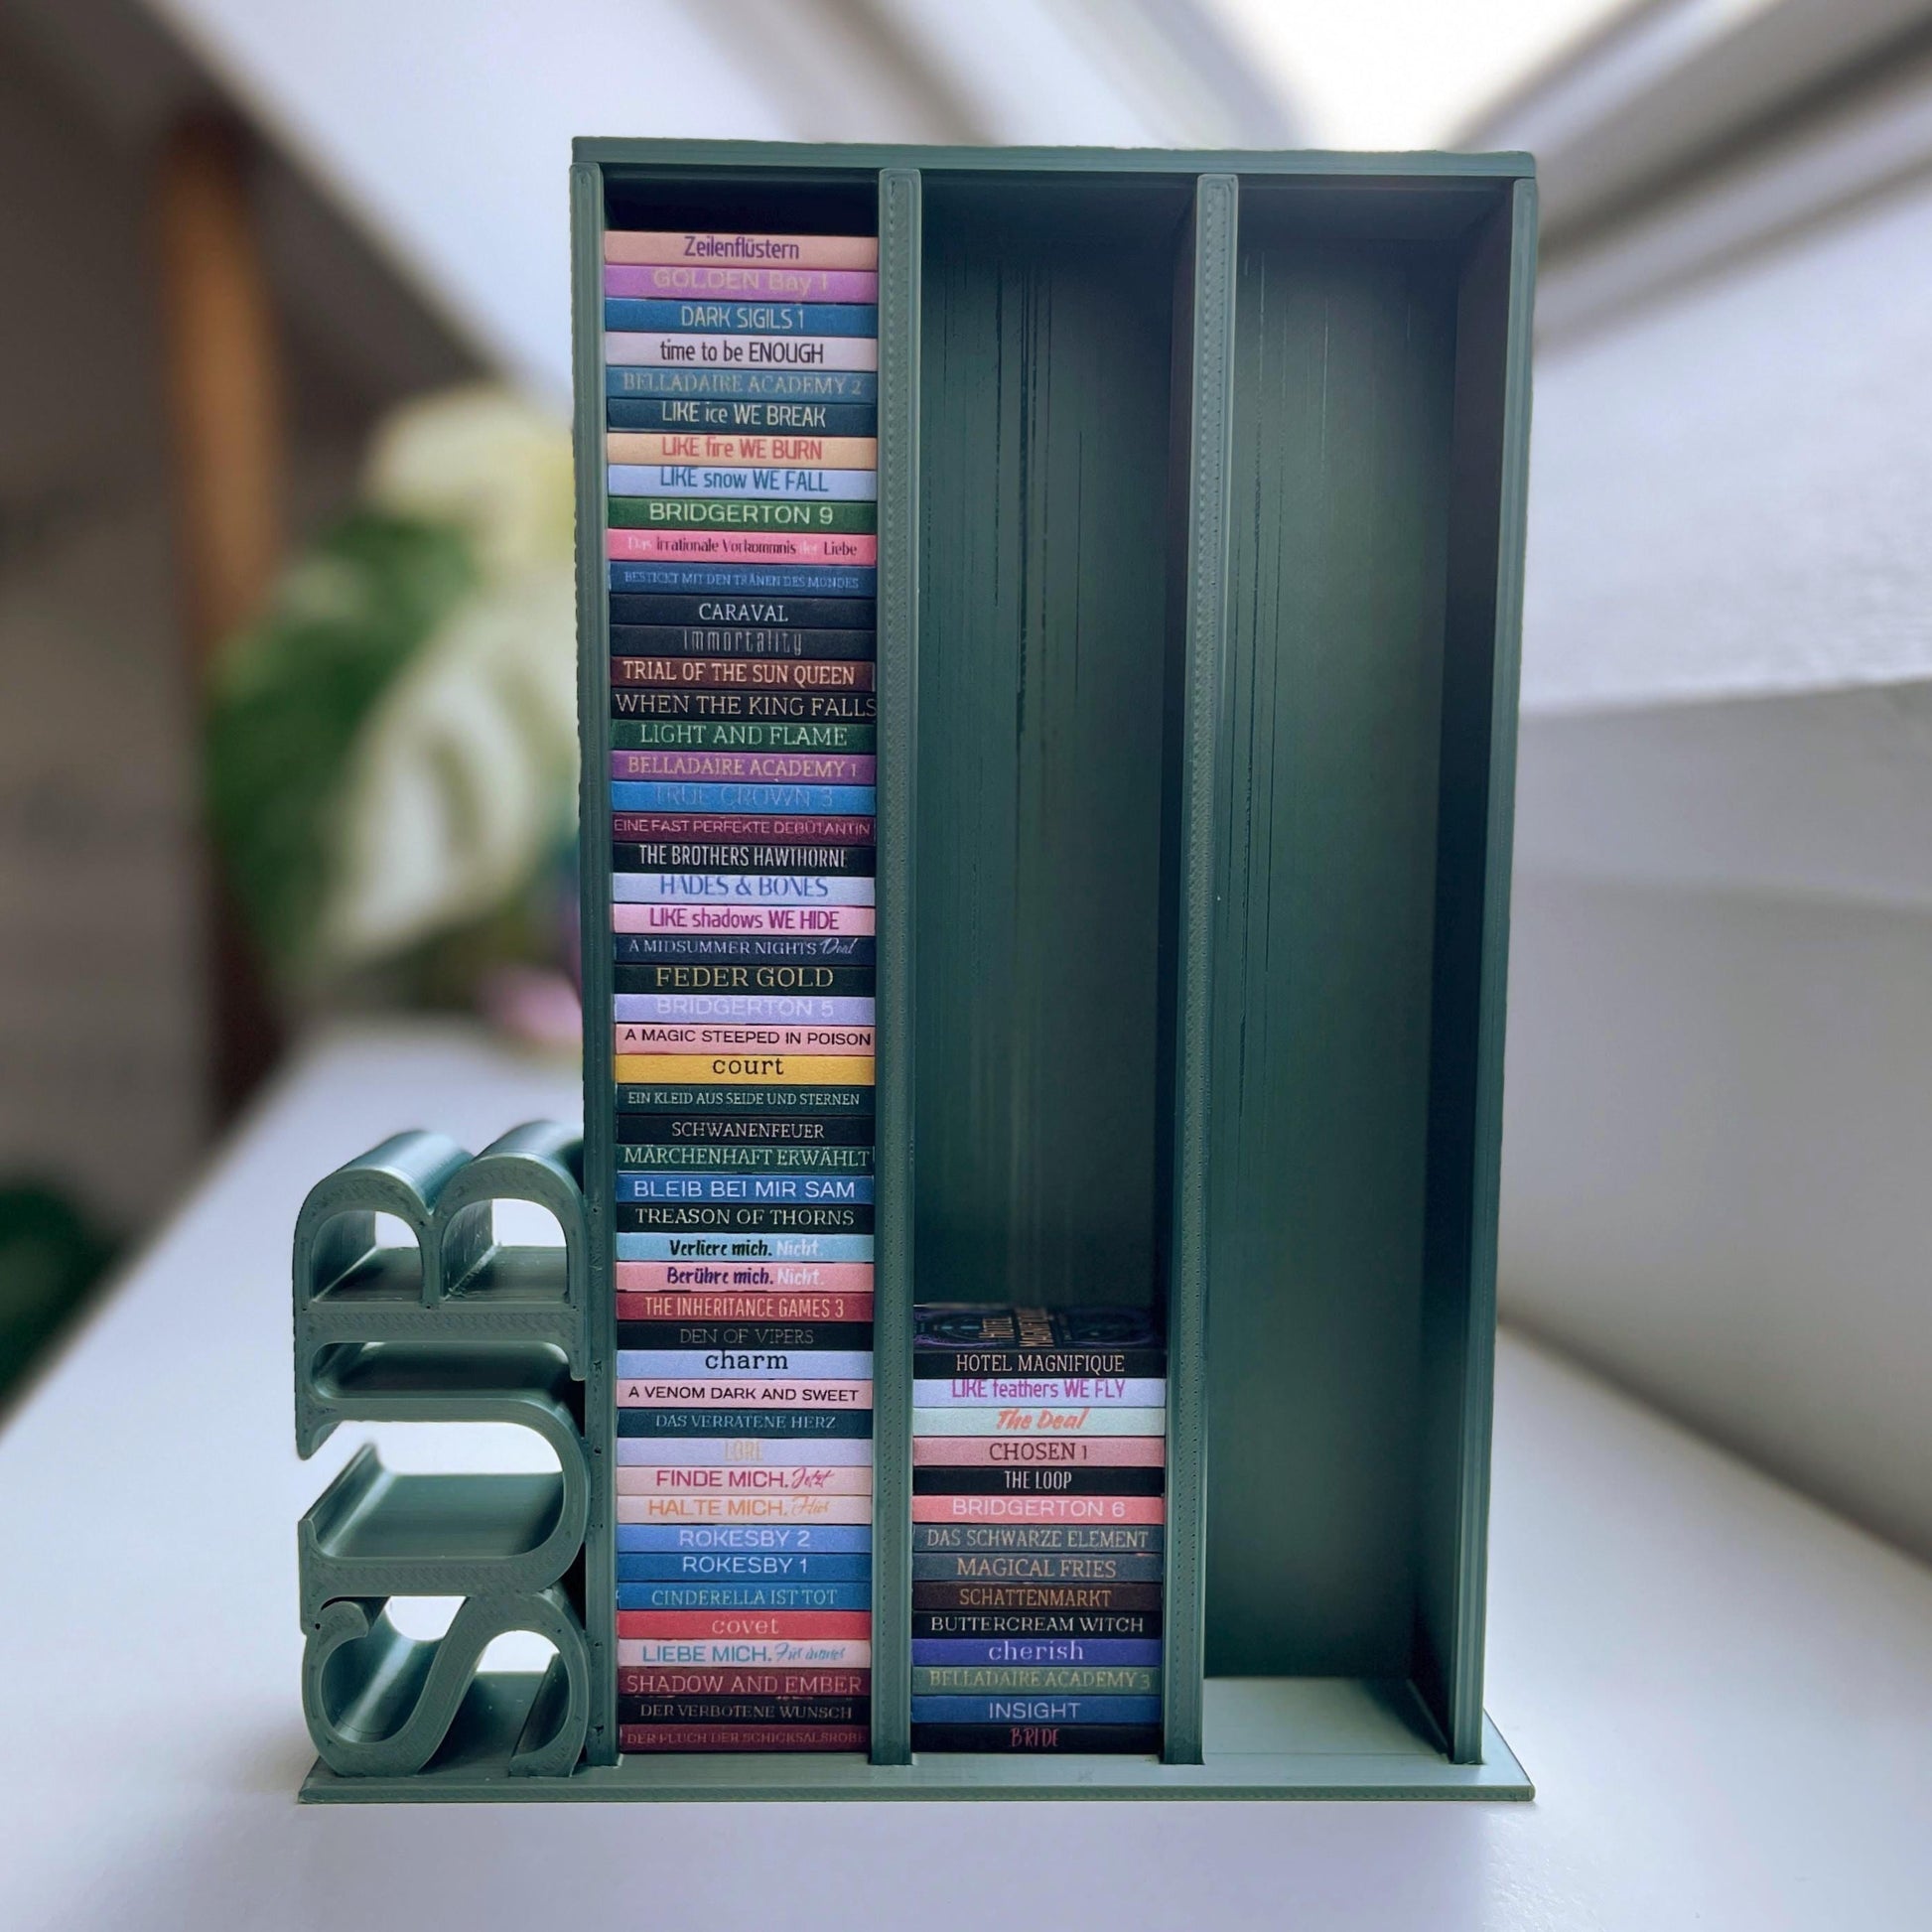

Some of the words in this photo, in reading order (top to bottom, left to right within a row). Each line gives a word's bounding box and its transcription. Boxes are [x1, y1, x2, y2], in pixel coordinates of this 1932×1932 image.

[684, 236, 799, 259] Zeilenflüstern
[682, 306, 731, 327] DARK
[737, 309, 792, 329] SIGILS
[797, 310, 803, 329] 1
[660, 339, 695, 360] time
[702, 342, 717, 361] to
[724, 342, 743, 361] be
[750, 343, 823, 363] ENOUGH
[662, 402, 699, 422] LIKE
[706, 402, 727, 424] ice
[734, 404, 760, 425] WE
[767, 405, 826, 428] BREAK
[662, 437, 699, 457] LIKE
[706, 436, 733, 457] fire
[739, 438, 765, 459] WE
[772, 440, 822, 460] BURN
[660, 468, 698, 486] LIKE
[704, 473, 747, 488] snow
[753, 470, 778, 489] WE
[786, 471, 828, 491] FALL
[649, 502, 809, 523] BRIDGERTON
[819, 506, 833, 524] 9
[699, 603, 788, 621] CARAVAL
[623, 660, 677, 680] TRIAL
[683, 662, 706, 680] OF
[712, 664, 747, 681] THE
[753, 665, 788, 683] SUN
[794, 666, 855, 688] QUEEN
[616, 694, 690, 713] WHEN
[696, 696, 742, 714] THE
[749, 697, 804, 715] KING
[811, 698, 877, 717] FALLS
[640, 724, 706, 744] LIGHT
[713, 726, 761, 745] AND
[770, 727, 847, 746] FLAME
[627, 757, 745, 775] BELLADAIRE
[751, 759, 845, 777] ACADEMY
[639, 844, 666, 865] THE
[672, 846, 749, 866] BROTHERS
[754, 847, 847, 867] HAWTHORNE
[660, 876, 729, 895] HADES
[736, 878, 752, 896] &
[759, 878, 828, 897] BONES
[650, 908, 686, 927] LIKE
[692, 908, 762, 928] shadows
[768, 909, 794, 929] WE
[800, 910, 839, 930] HIDE
[629, 940, 639, 951] A
[644, 940, 749, 953] MIDSUMMER
[756, 942, 817, 955] NIGHTS
[656, 967, 748, 987] FEDER
[757, 968, 834, 988] GOLD
[656, 999, 811, 1017] BRIDGERTON
[821, 1001, 833, 1017] 5
[625, 1031, 636, 1040] A
[642, 1030, 695, 1042] MAGIC
[702, 1031, 779, 1043] STEEPED
[786, 1033, 801, 1044] IN
[807, 1033, 871, 1045] POISON
[713, 1059, 783, 1074] court
[628, 1092, 650, 1104] EIN
[654, 1092, 692, 1104] KLEID
[696, 1093, 723, 1104] AUS
[727, 1093, 762, 1104] SEIDE
[766, 1093, 796, 1104] UND
[800, 1093, 860, 1105] STERNEN
[672, 1122, 824, 1139] SCHWANENFEUER
[624, 1145, 773, 1166] MÄRCHENHAFT
[777, 1146, 870, 1167] ERWÄHLT
[634, 1180, 702, 1197] BLEIB
[711, 1181, 746, 1197] BEI
[756, 1181, 796, 1197] MIR
[805, 1181, 855, 1198] SAM
[635, 1208, 730, 1224] TREASON
[737, 1209, 764, 1224] OF
[770, 1209, 854, 1225] THORNS
[670, 1239, 727, 1256] Verliere
[732, 1240, 772, 1257] mich.
[776, 1241, 823, 1257] Nicht.
[667, 1267, 729, 1284] Berühre
[734, 1269, 773, 1285] mich.
[777, 1270, 825, 1286] Nicht.
[645, 1298, 671, 1315] THE
[677, 1298, 773, 1317] INHERITANCE
[779, 1299, 830, 1318] GAMES
[835, 1300, 843, 1317] 3
[680, 1328, 718, 1343] DEN
[724, 1328, 749, 1343] OF
[755, 1329, 814, 1344] VIPERS
[705, 1350, 788, 1369] charm
[956, 1355, 1013, 1372] HOTEL
[1018, 1355, 1125, 1374] MAGNIFIQUE
[628, 1387, 639, 1398] A
[645, 1387, 705, 1399] VENOM
[711, 1388, 756, 1400] DARK
[761, 1388, 796, 1401] AND
[802, 1389, 859, 1402] SWEET
[952, 1379, 988, 1398] LIKE
[993, 1379, 1058, 1398] feathers
[1064, 1379, 1090, 1398] WE
[1095, 1379, 1125, 1398] FLY
[656, 1416, 687, 1427] DAS
[692, 1416, 786, 1428] VERRATENE
[791, 1417, 835, 1428] HERZ
[997, 1409, 1031, 1430] The
[1036, 1408, 1091, 1430] Deal
[293, 1137, 588, 1777] SUB
[990, 1443, 1076, 1461] CHOSEN
[656, 1470, 723, 1487] FINDE
[729, 1470, 788, 1488] MICH.
[1005, 1470, 1031, 1488] THE
[1035, 1471, 1072, 1489] LOOP
[648, 1499, 722, 1516] HALTE
[729, 1500, 788, 1518] MICH.
[953, 1498, 1103, 1516] BRIDGERTON
[1112, 1501, 1125, 1517] 6
[679, 1530, 790, 1547] ROKESBY
[797, 1531, 810, 1547] 2
[927, 1529, 961, 1546] DAS
[968, 1530, 1061, 1547] SCHWARZE
[1068, 1531, 1150, 1548] ELEMENT
[683, 1556, 792, 1573] ROKESBY
[800, 1558, 806, 1573] 1
[957, 1558, 1055, 1577] MAGICAL
[1060, 1561, 1117, 1579] FRIES
[652, 1589, 766, 1606] CINDERELLA
[770, 1589, 796, 1605] IST
[802, 1589, 837, 1605] TOT
[960, 1588, 1112, 1606] SCHATTENMARKT
[712, 1618, 779, 1634] covet
[931, 1616, 1074, 1631] BUTTERCREAM
[1079, 1617, 1144, 1632] WITCH
[642, 1646, 706, 1663] LIEBE
[712, 1646, 771, 1663] MICH.
[989, 1641, 1084, 1661] cherish
[626, 1676, 724, 1693] SHADOW
[731, 1676, 778, 1693] AND
[785, 1676, 862, 1693] EMBER
[929, 1670, 1043, 1687] BELLADAIRE
[1045, 1670, 1138, 1688] ACADEMY
[1141, 1675, 1151, 1689] 3
[640, 1704, 674, 1717] DER
[678, 1705, 775, 1718] VERBOTENE
[779, 1706, 852, 1719] WUNSCH
[990, 1703, 1080, 1720] INSIGHT
[1011, 1727, 1059, 1747] BRIDE
